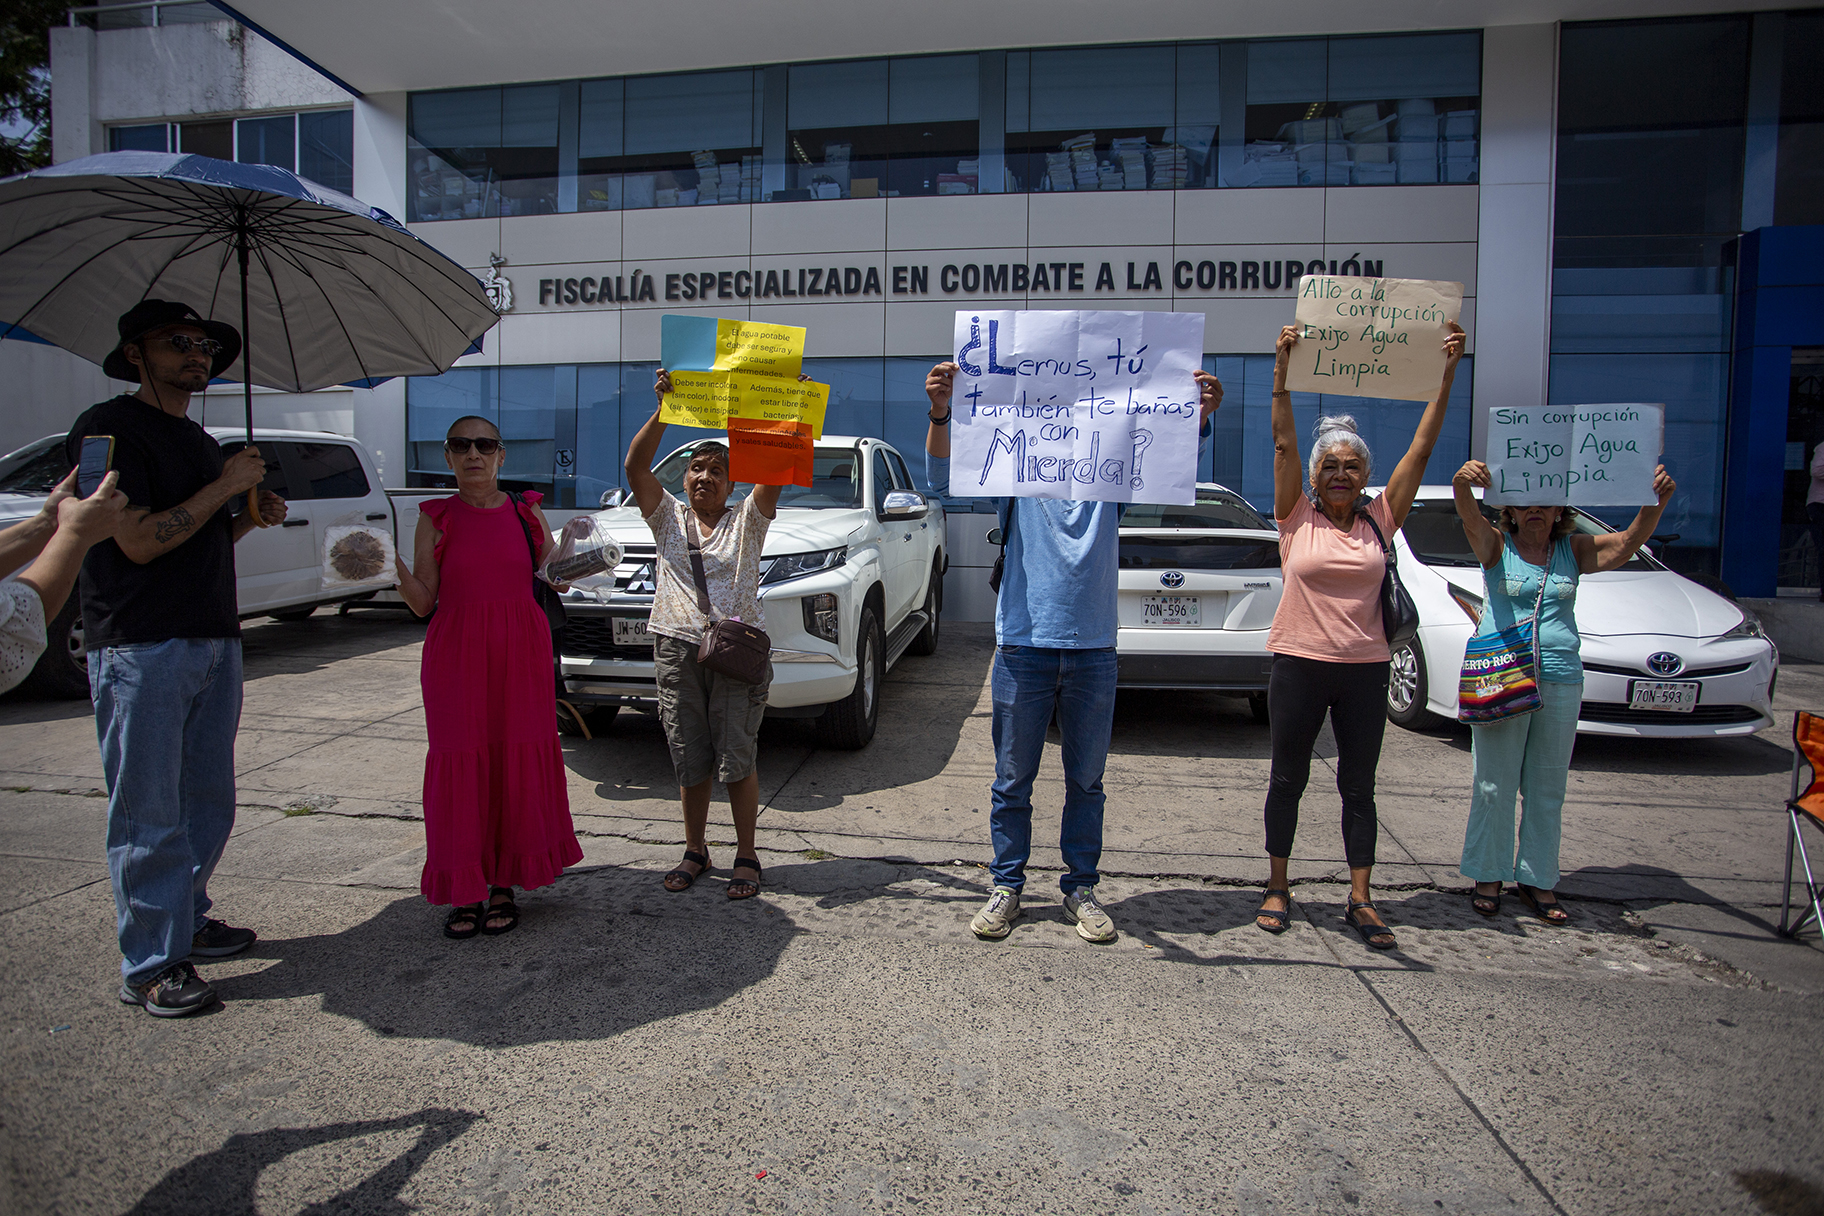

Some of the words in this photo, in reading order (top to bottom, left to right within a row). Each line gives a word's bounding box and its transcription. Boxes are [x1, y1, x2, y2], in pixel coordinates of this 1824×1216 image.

[539, 268, 656, 305] FISCALÍA
[665, 266, 882, 301] ESPECIALIZADA
[892, 264, 929, 294] EN
[940, 262, 1086, 294] COMBATE
[1096, 262, 1116, 290] A
[1126, 261, 1163, 291] LA
[1303, 278, 1343, 299] Alto
[1350, 287, 1363, 300] a
[1370, 279, 1386, 302] la
[731, 328, 740, 337] El
[740, 330, 759, 339] agua
[760, 332, 791, 342] potable
[1359, 323, 1409, 355] Agua
[726, 341, 746, 350] debe
[747, 343, 759, 351] ser
[760, 344, 787, 354] segura
[787, 348, 793, 356] y
[1107, 337, 1149, 376] tú
[749, 356, 777, 366] causar
[1313, 348, 1391, 388] Limpia
[726, 366, 786, 379] enfermedades.
[675, 378, 695, 387] Debe
[695, 380, 708, 388] ser
[708, 380, 738, 390] incolora
[749, 382, 785, 395] Además,
[786, 386, 806, 396] tiene
[806, 390, 821, 399] que
[671, 391, 686, 400] (sin
[686, 392, 710, 402] color),
[711, 393, 740, 403] inodora
[760, 398, 780, 407] estar
[781, 399, 799, 408] libre
[799, 401, 809, 409] de
[964, 383, 1071, 419] también
[1078, 386, 1116, 420] te
[1125, 387, 1196, 419] bañas
[669, 402, 684, 411] (sin
[685, 404, 703, 414] olor)
[763, 410, 799, 420] bacterias
[799, 414, 804, 422] y
[682, 416, 697, 425] (sin
[697, 418, 724, 428] sabor).
[1496, 408, 1529, 426] Sin
[1542, 406, 1640, 431] corrupción
[1039, 422, 1080, 442] con
[741, 438, 761, 446] sales
[762, 439, 807, 451] saludables.
[1579, 432, 1640, 464] Agua
[1500, 464, 1615, 498] Limpia.
[1144, 603, 1188, 617] 70N-596
[1492, 651, 1517, 668] RICO
[1635, 688, 1683, 704] 70N-593
